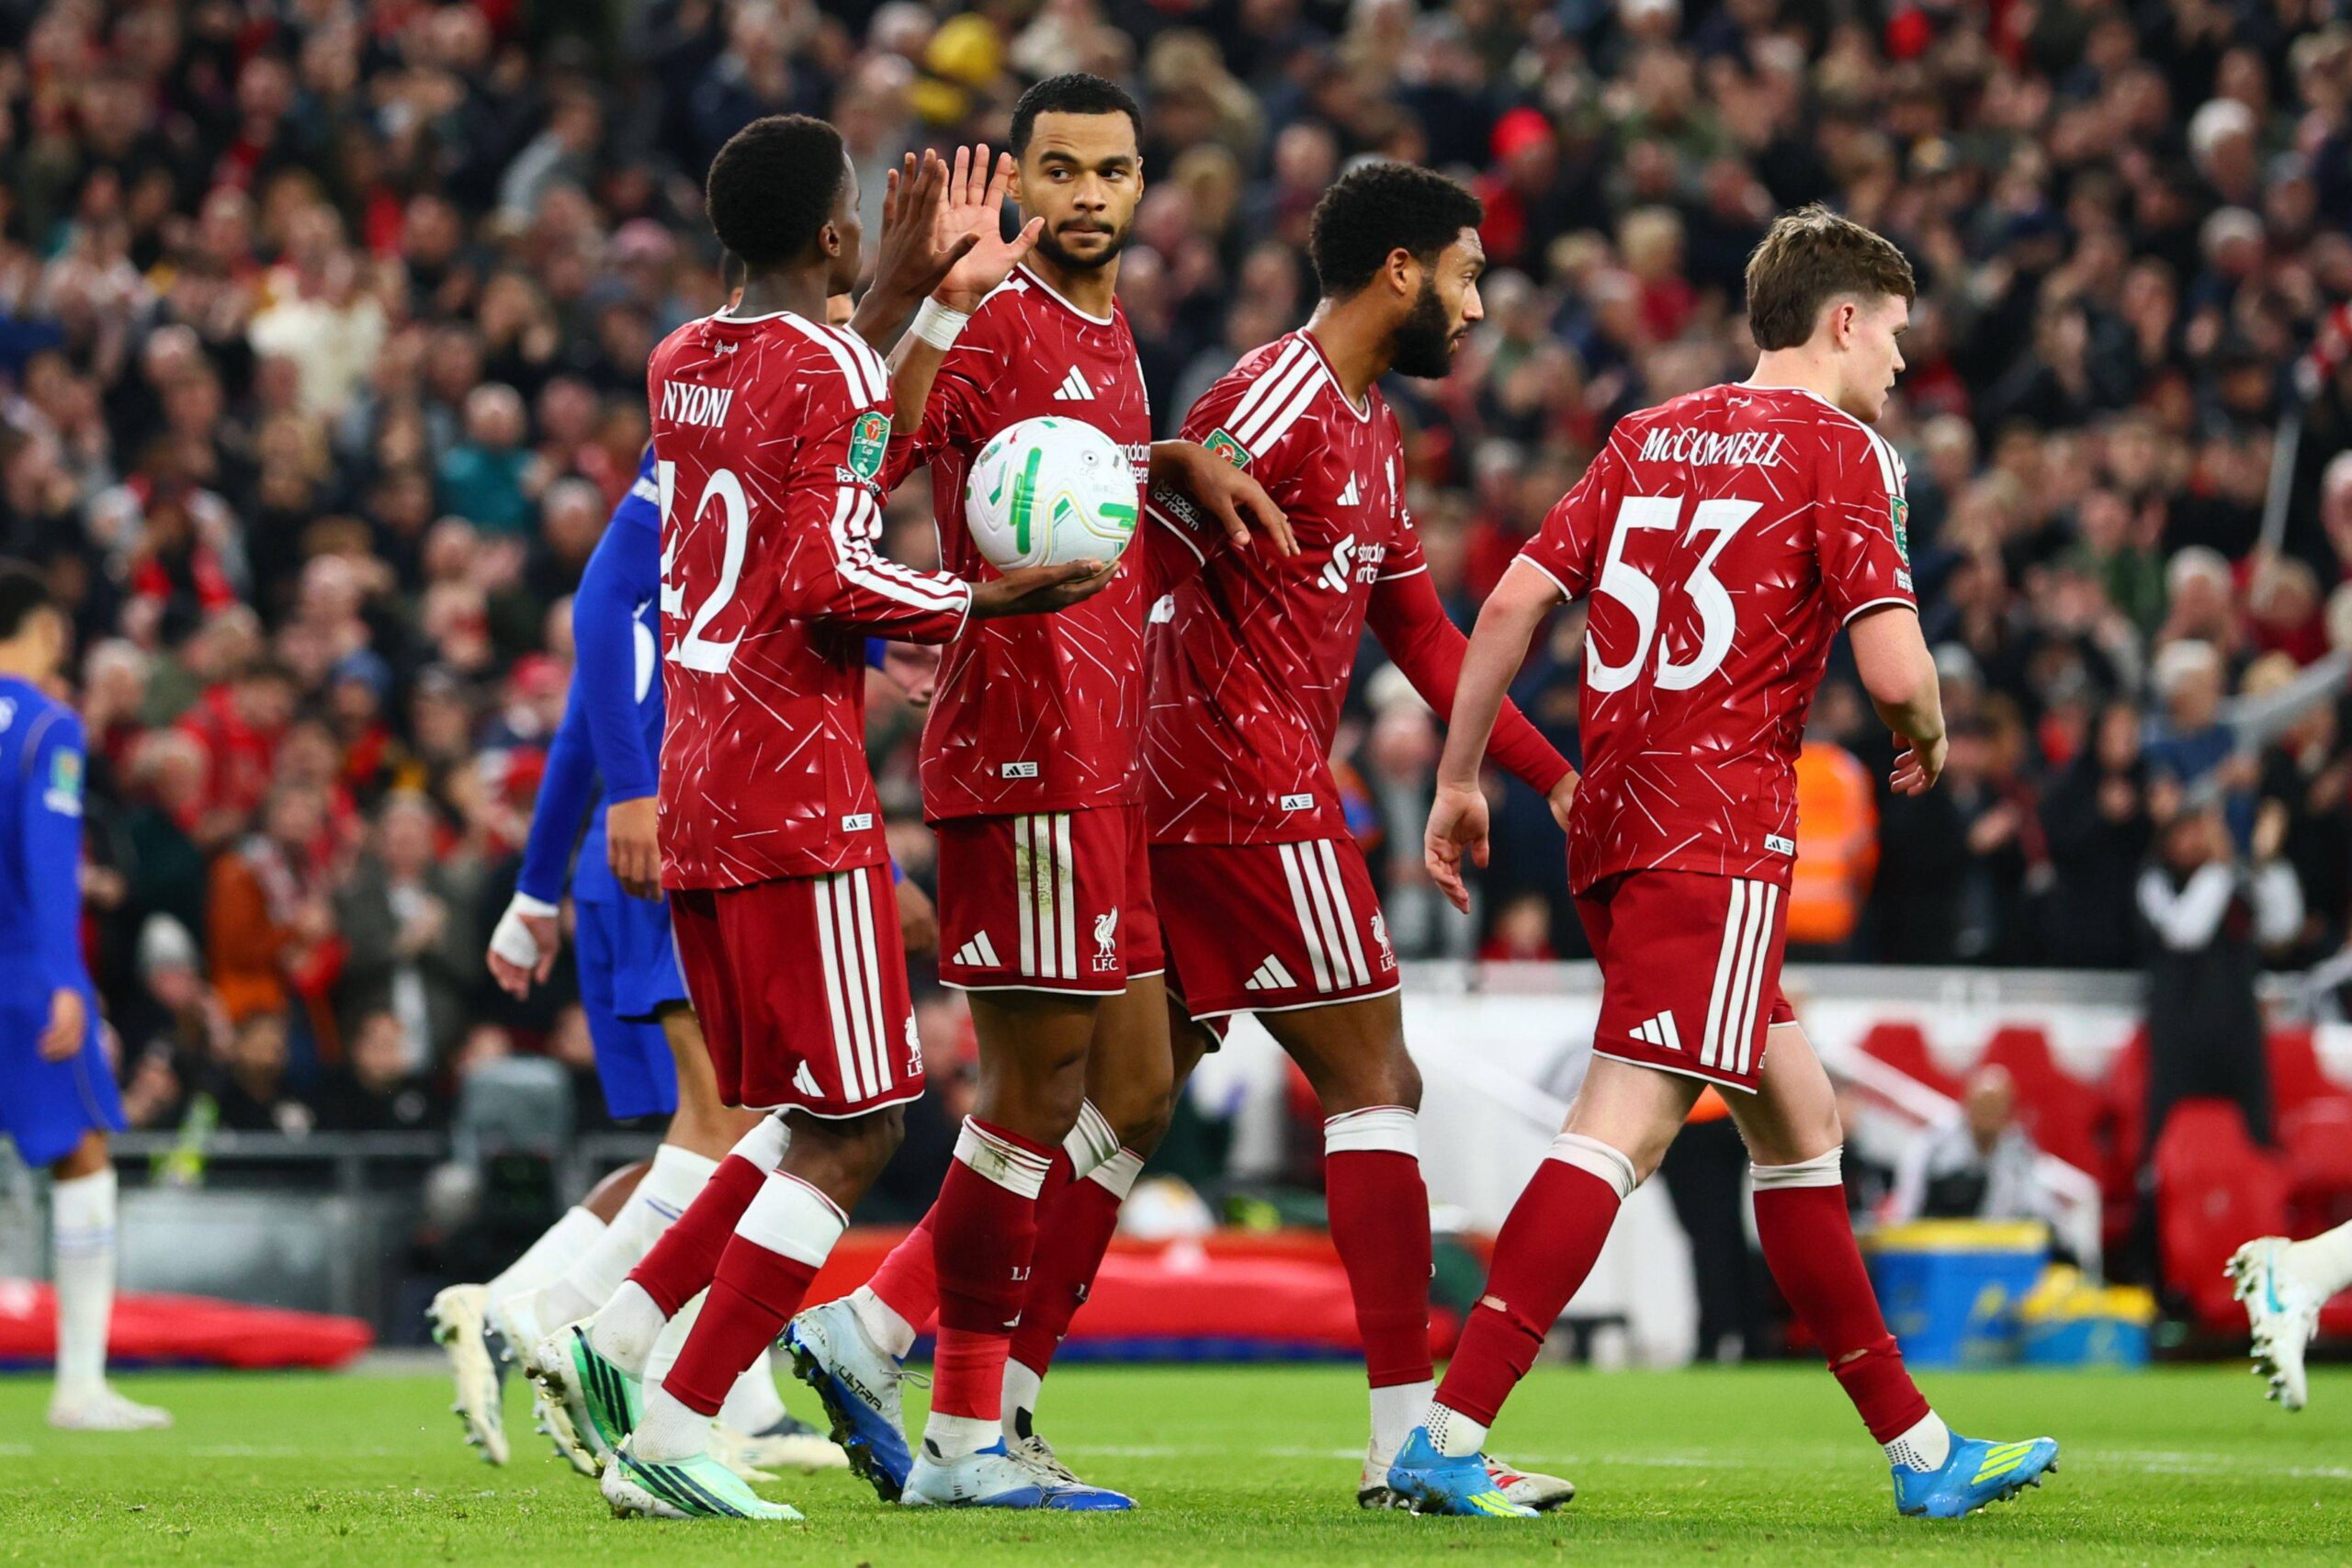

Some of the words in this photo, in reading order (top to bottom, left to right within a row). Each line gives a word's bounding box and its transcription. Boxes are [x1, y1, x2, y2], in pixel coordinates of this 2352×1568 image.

[660, 378, 734, 429] NYONI
[1638, 426, 1785, 468] McCONNELL
[1165, 501, 1199, 531] racism
[1585, 494, 1765, 694] 53
[838, 1365, 883, 1411] ULTRA
